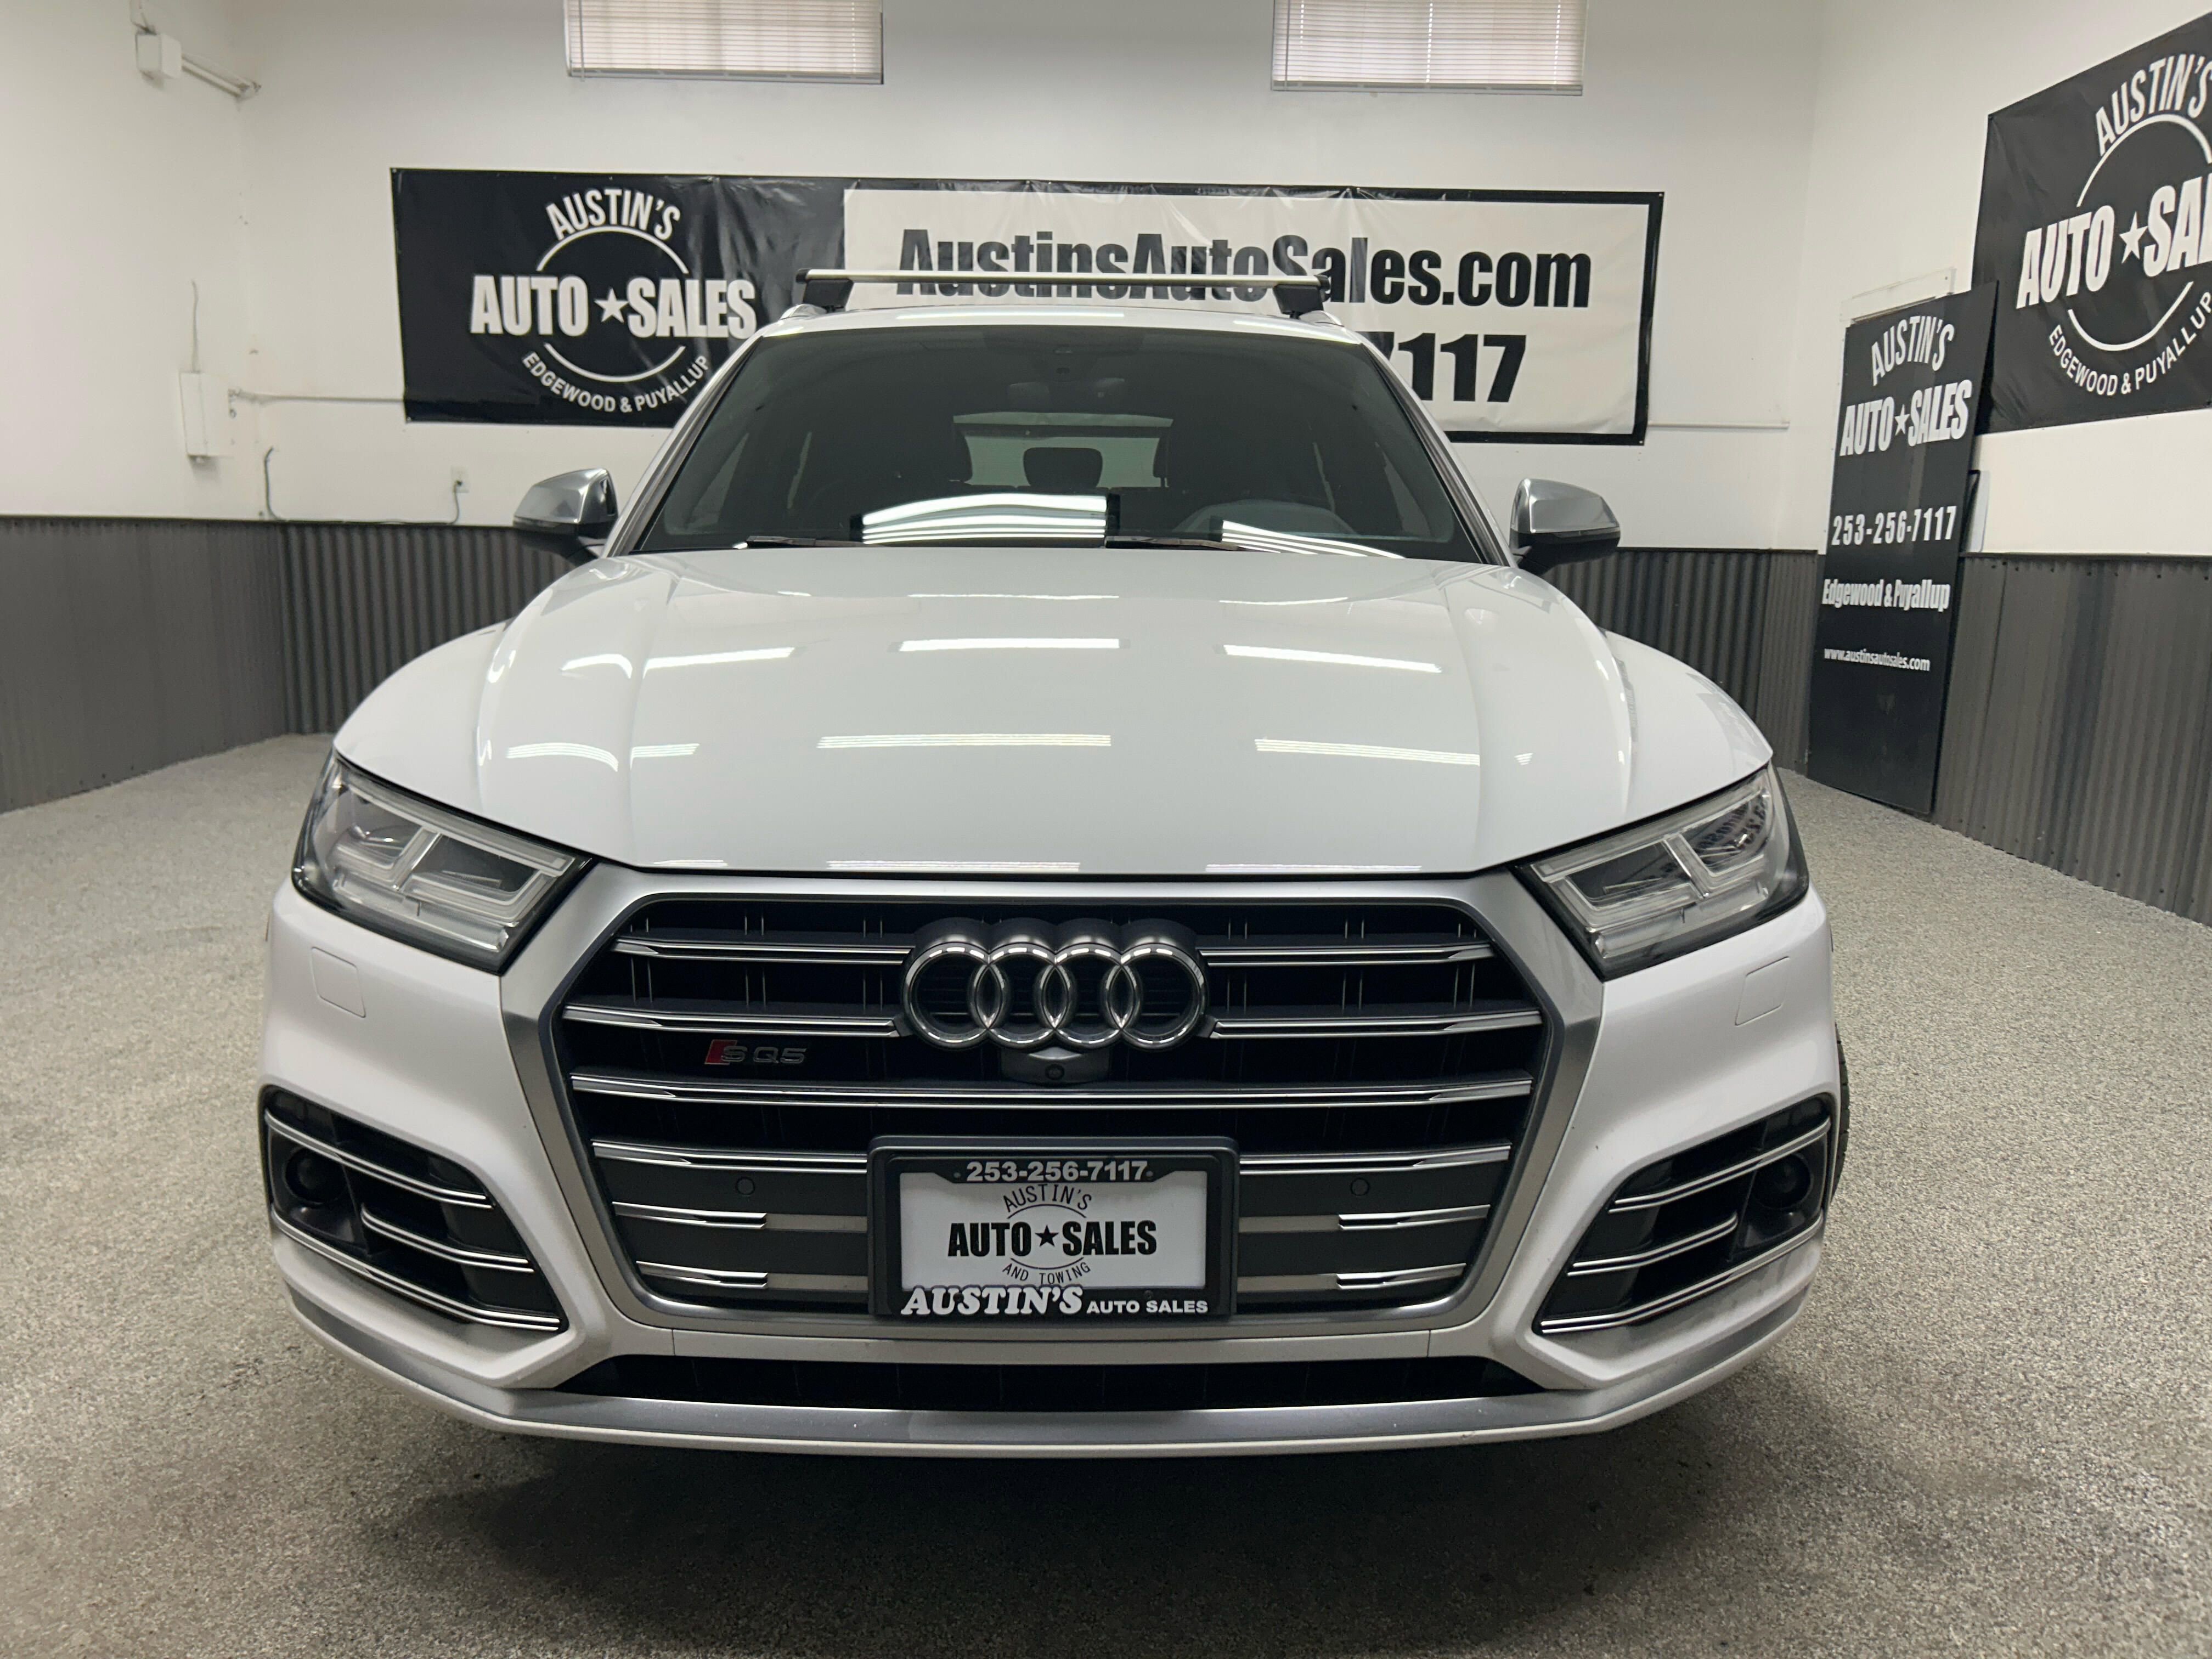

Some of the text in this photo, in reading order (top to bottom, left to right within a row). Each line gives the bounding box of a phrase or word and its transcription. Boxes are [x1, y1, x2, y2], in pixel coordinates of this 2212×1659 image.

[2095, 54, 2212, 156] AUSTIN'S
[546, 189, 680, 241] AUSTIN'S
[896, 229, 1590, 307] AustinsAutoSales.com
[2016, 205, 2114, 308] AUTO
[471, 275, 757, 339] AUTO SALES
[1871, 316, 1954, 386] AUSTIN'S
[2049, 292, 2211, 396] EDGEWOOD & PUYALLUP
[523, 352, 709, 413] EDGEWOOD & PUYALLUP
[1839, 380, 1972, 456] AUTO SALES
[1832, 506, 1956, 545] 253-256-7117
[1822, 579, 1951, 612] Edgewood & Puyallup
[1824, 648, 1931, 671] www.austinsautosales.com
[721, 1045, 806, 1064] SQ5
[967, 1161, 1147, 1181] 253-256-7117
[1003, 1183, 1092, 1212] AUSTIN'S
[948, 1220, 1156, 1257] AUTO SALES
[1002, 1262, 1091, 1285] AND TOWING
[901, 1286, 1208, 1315] AUSTIN'S AUTO SALES
